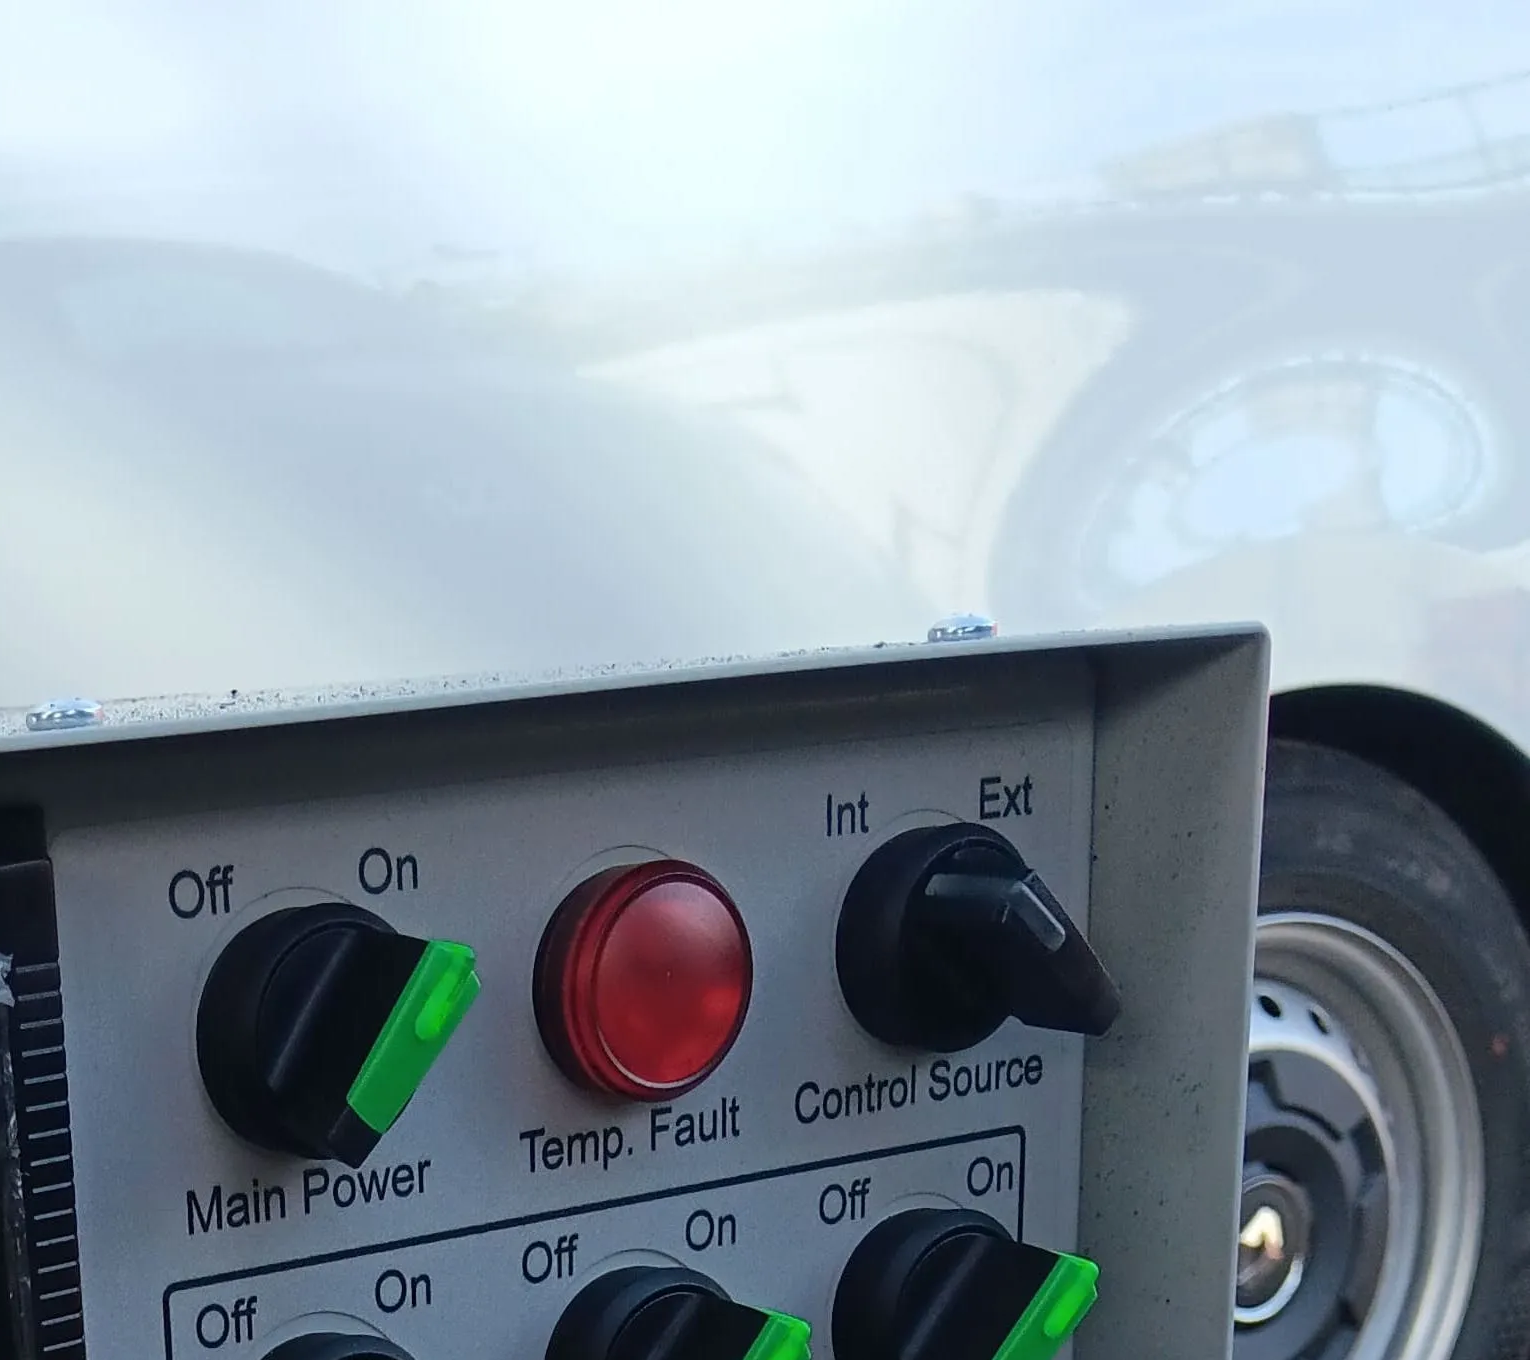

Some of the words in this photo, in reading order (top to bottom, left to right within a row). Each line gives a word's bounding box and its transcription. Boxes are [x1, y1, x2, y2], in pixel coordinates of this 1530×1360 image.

[826, 793, 869, 837] Int
[979, 776, 1034, 820] Ext
[169, 864, 234, 919] Off
[359, 847, 419, 895] On
[795, 1065, 916, 1125] Control
[928, 1054, 1043, 1102] Source
[520, 1127, 634, 1172] Temp.
[650, 1097, 740, 1152] Fault
[186, 1178, 286, 1236] Main
[303, 1158, 431, 1215] Power
[819, 1177, 871, 1225] Off
[967, 1157, 1013, 1197] On
[686, 1210, 736, 1251] On
[522, 1233, 578, 1284] Off
[375, 1270, 431, 1312] On
[196, 1296, 258, 1349] Off
